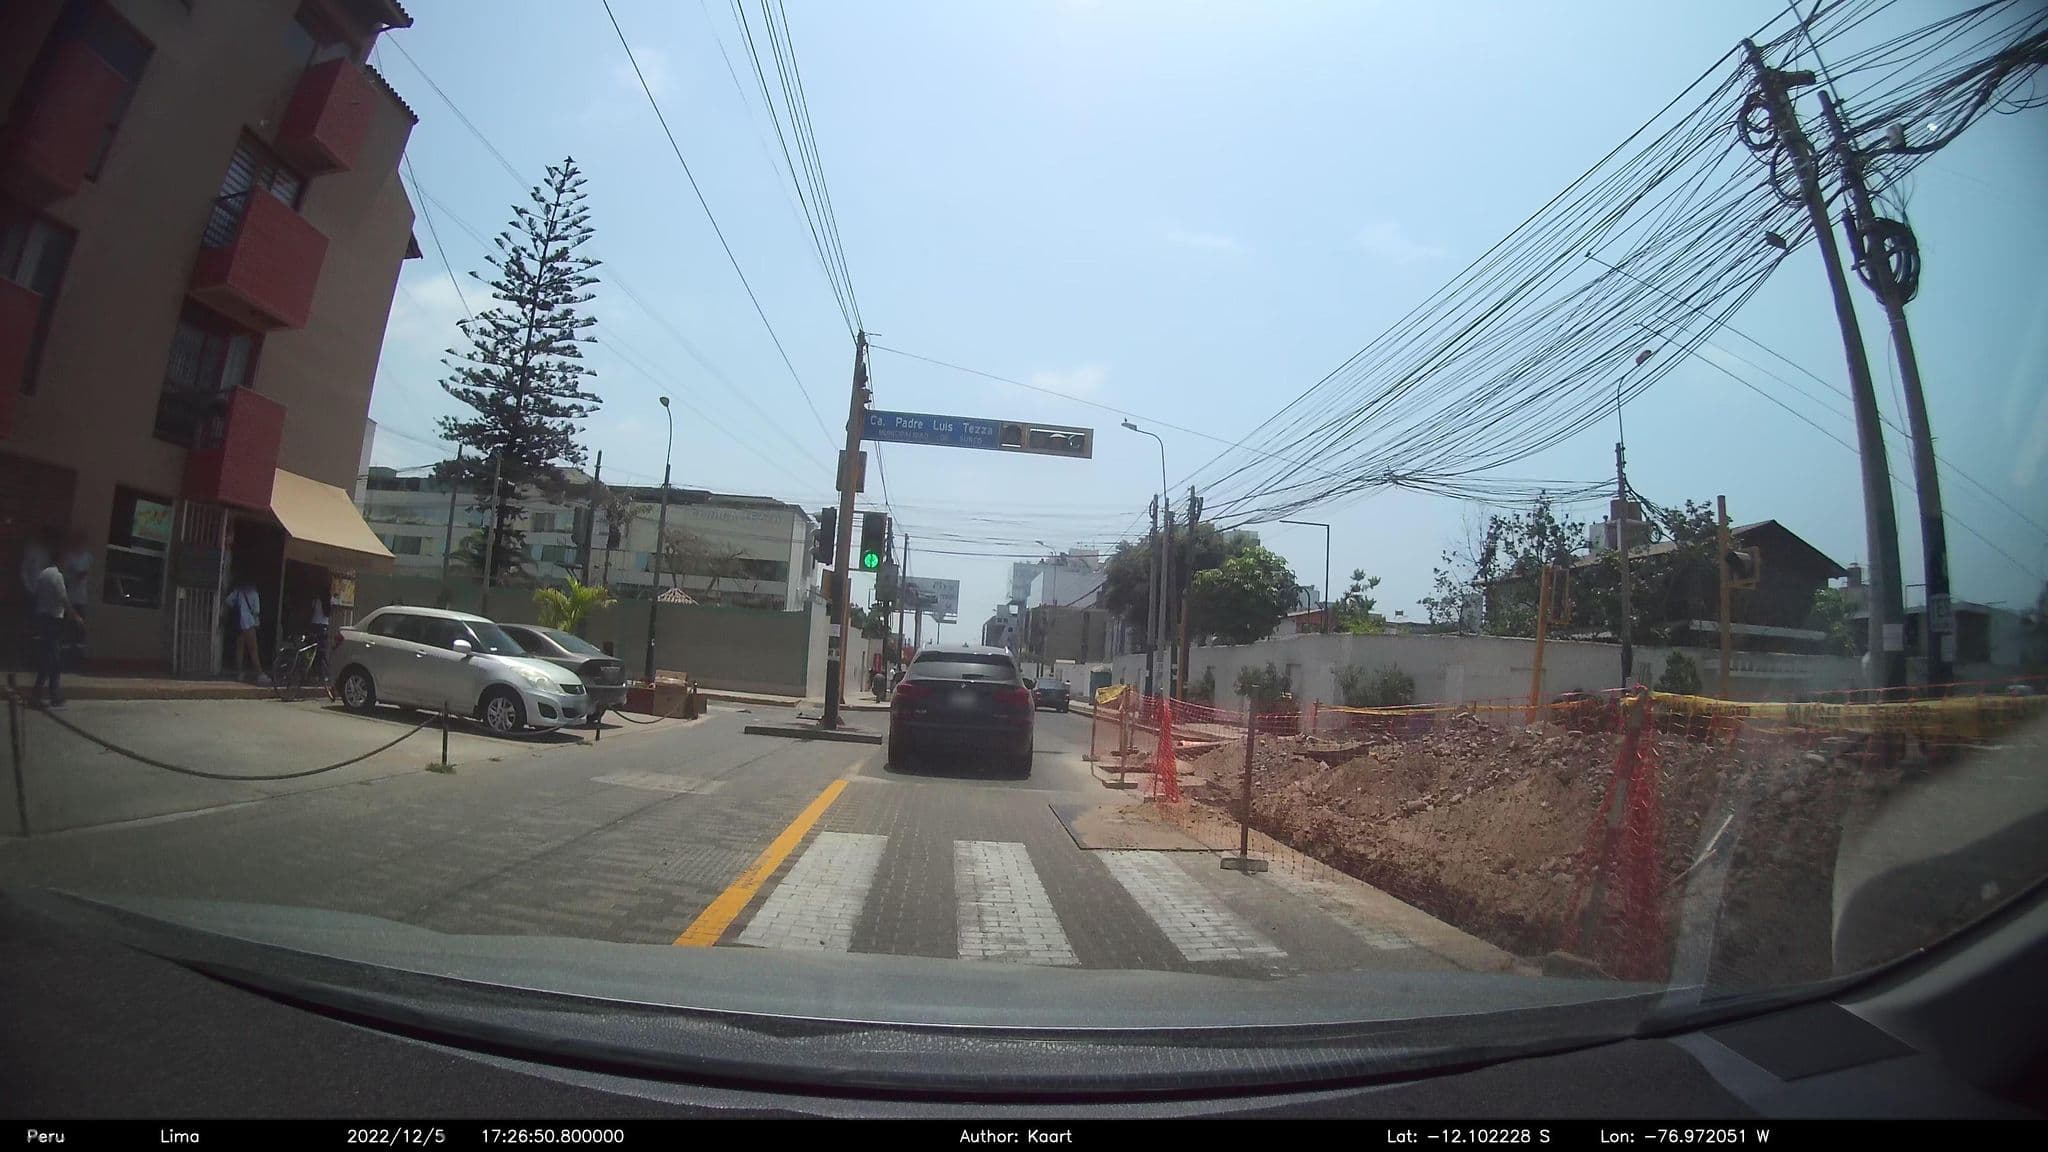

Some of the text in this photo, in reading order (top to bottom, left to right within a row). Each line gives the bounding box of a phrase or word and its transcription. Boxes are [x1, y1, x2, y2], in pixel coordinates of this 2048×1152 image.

[870, 415, 993, 436] Ca. Padre Luis Tezza
